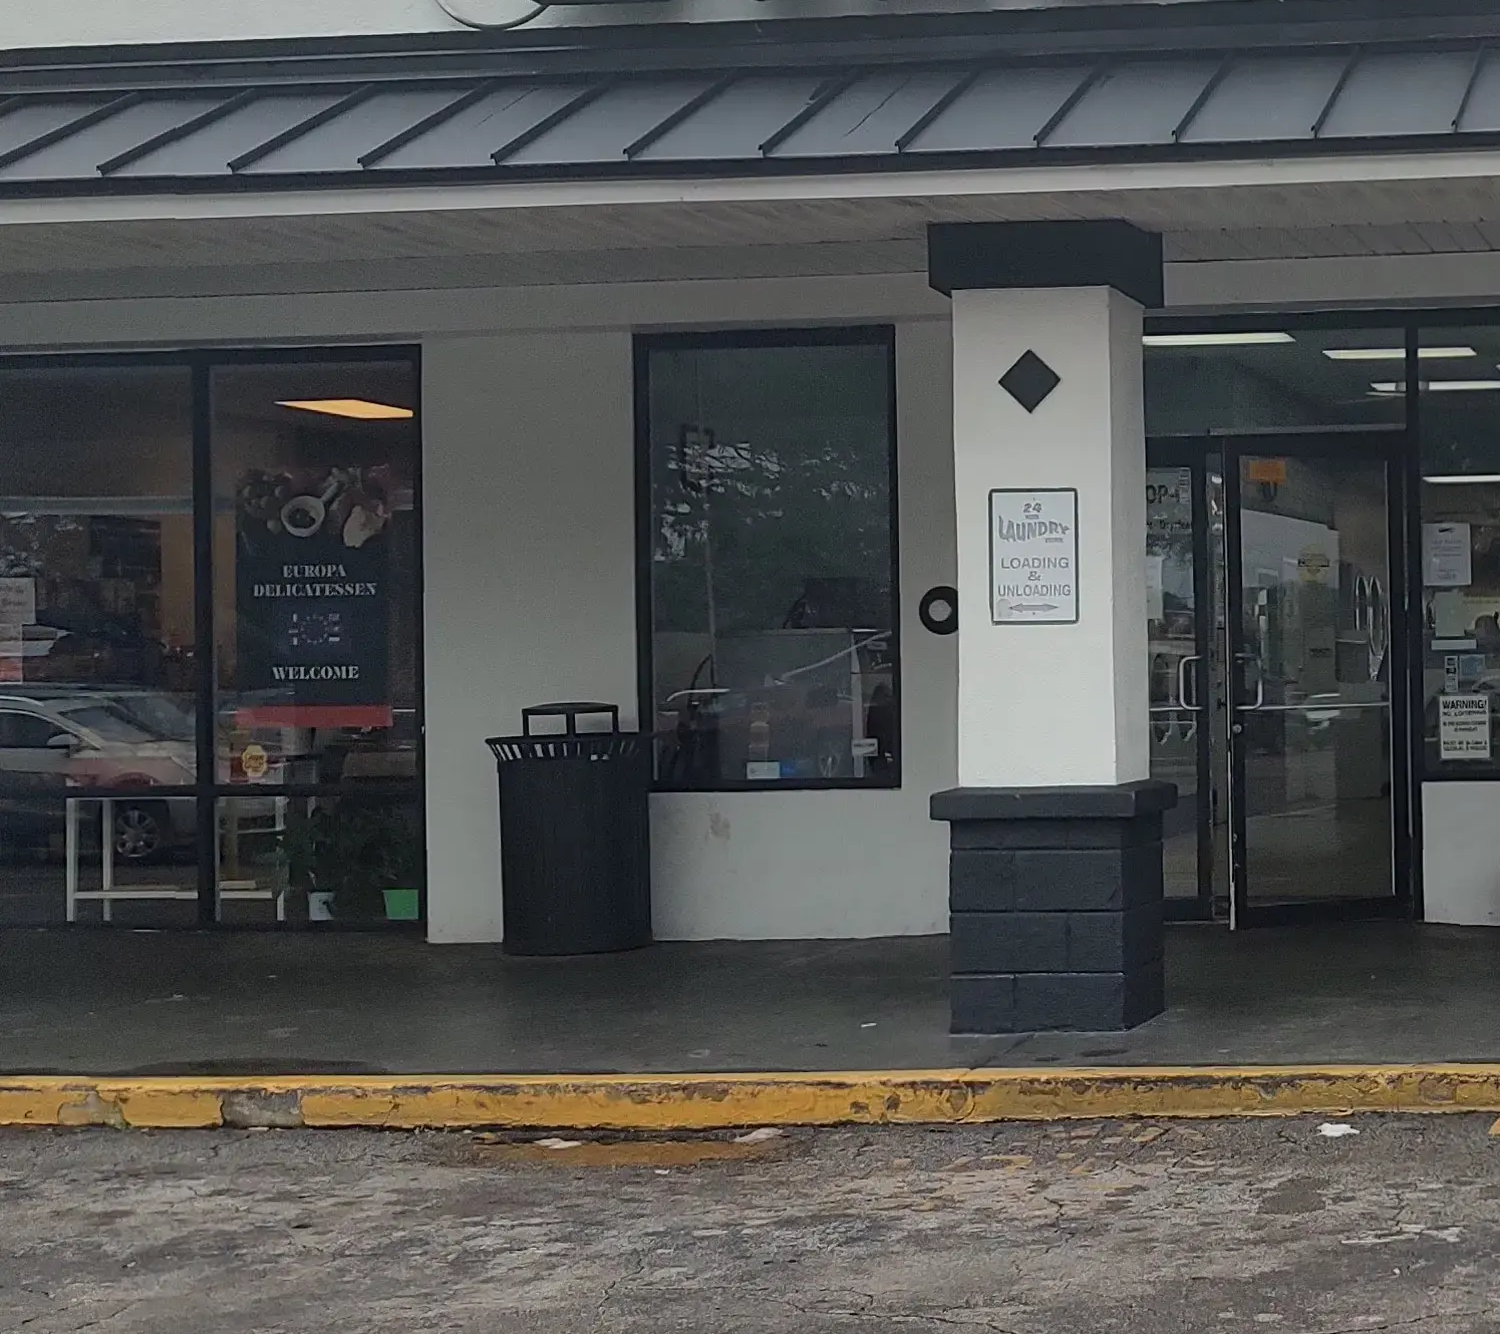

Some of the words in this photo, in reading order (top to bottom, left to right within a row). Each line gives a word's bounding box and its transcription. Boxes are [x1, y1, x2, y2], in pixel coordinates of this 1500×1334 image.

[1023, 502, 1042, 513] 24
[998, 515, 1070, 542] LAUNDRY
[1001, 557, 1069, 569] LOADING
[282, 564, 347, 578] EUROPA
[1028, 571, 1041, 581] &
[253, 583, 377, 597] DELICATESSEN
[998, 584, 1072, 597] UNLOADING
[272, 666, 359, 680] WELCOME
[1442, 699, 1487, 709] WARNING!
